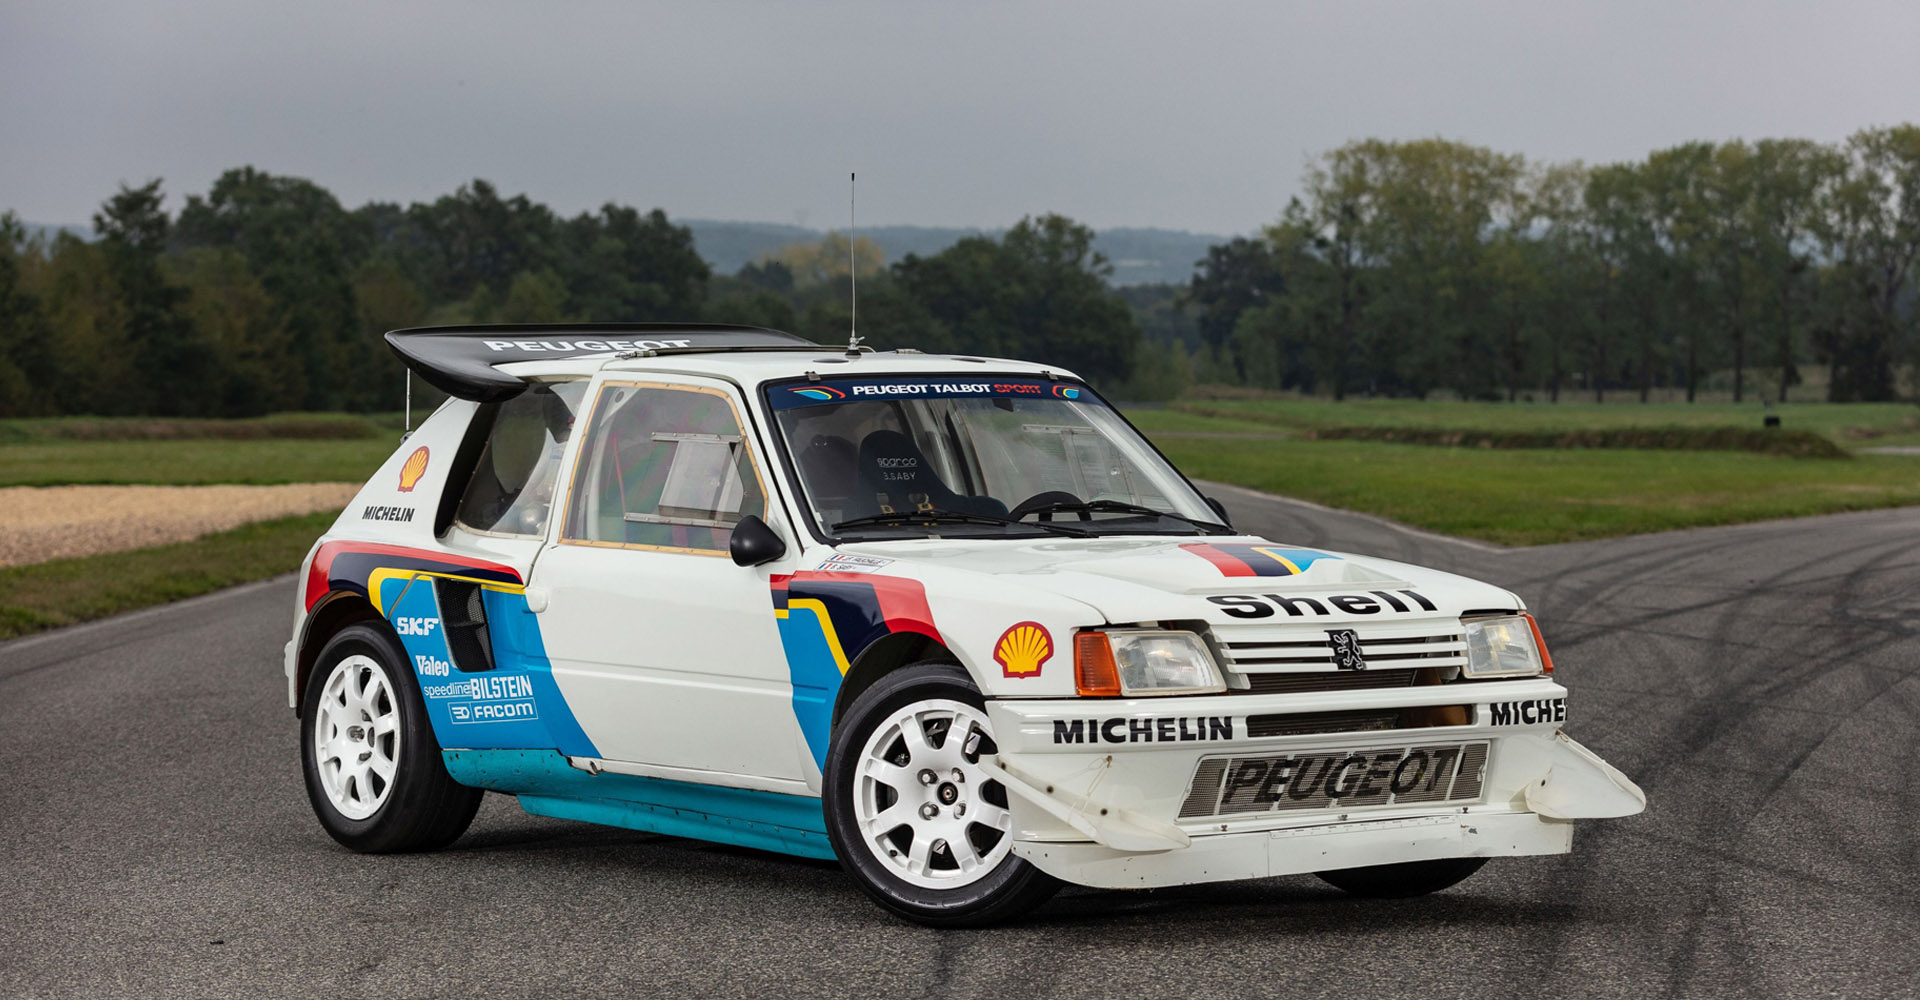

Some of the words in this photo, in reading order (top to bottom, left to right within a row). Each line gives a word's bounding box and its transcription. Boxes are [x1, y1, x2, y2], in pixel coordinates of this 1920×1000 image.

[483, 339, 690, 352] PEUGEOT
[852, 384, 928, 396] PEUGEOT
[930, 383, 991, 395] TALBOT
[994, 384, 1041, 394] SPORT
[362, 505, 415, 522] MICHELIN
[1206, 589, 1438, 619] Shell
[396, 616, 439, 636] SKF
[415, 655, 449, 677] Valeo
[423, 682, 469, 698] speedline
[470, 675, 533, 700] BILSTEIN
[474, 702, 534, 719] FACOM
[1489, 697, 1568, 726] MICHE
[1053, 715, 1233, 744] MICHELIN
[1221, 748, 1460, 805] PEUGEOT
